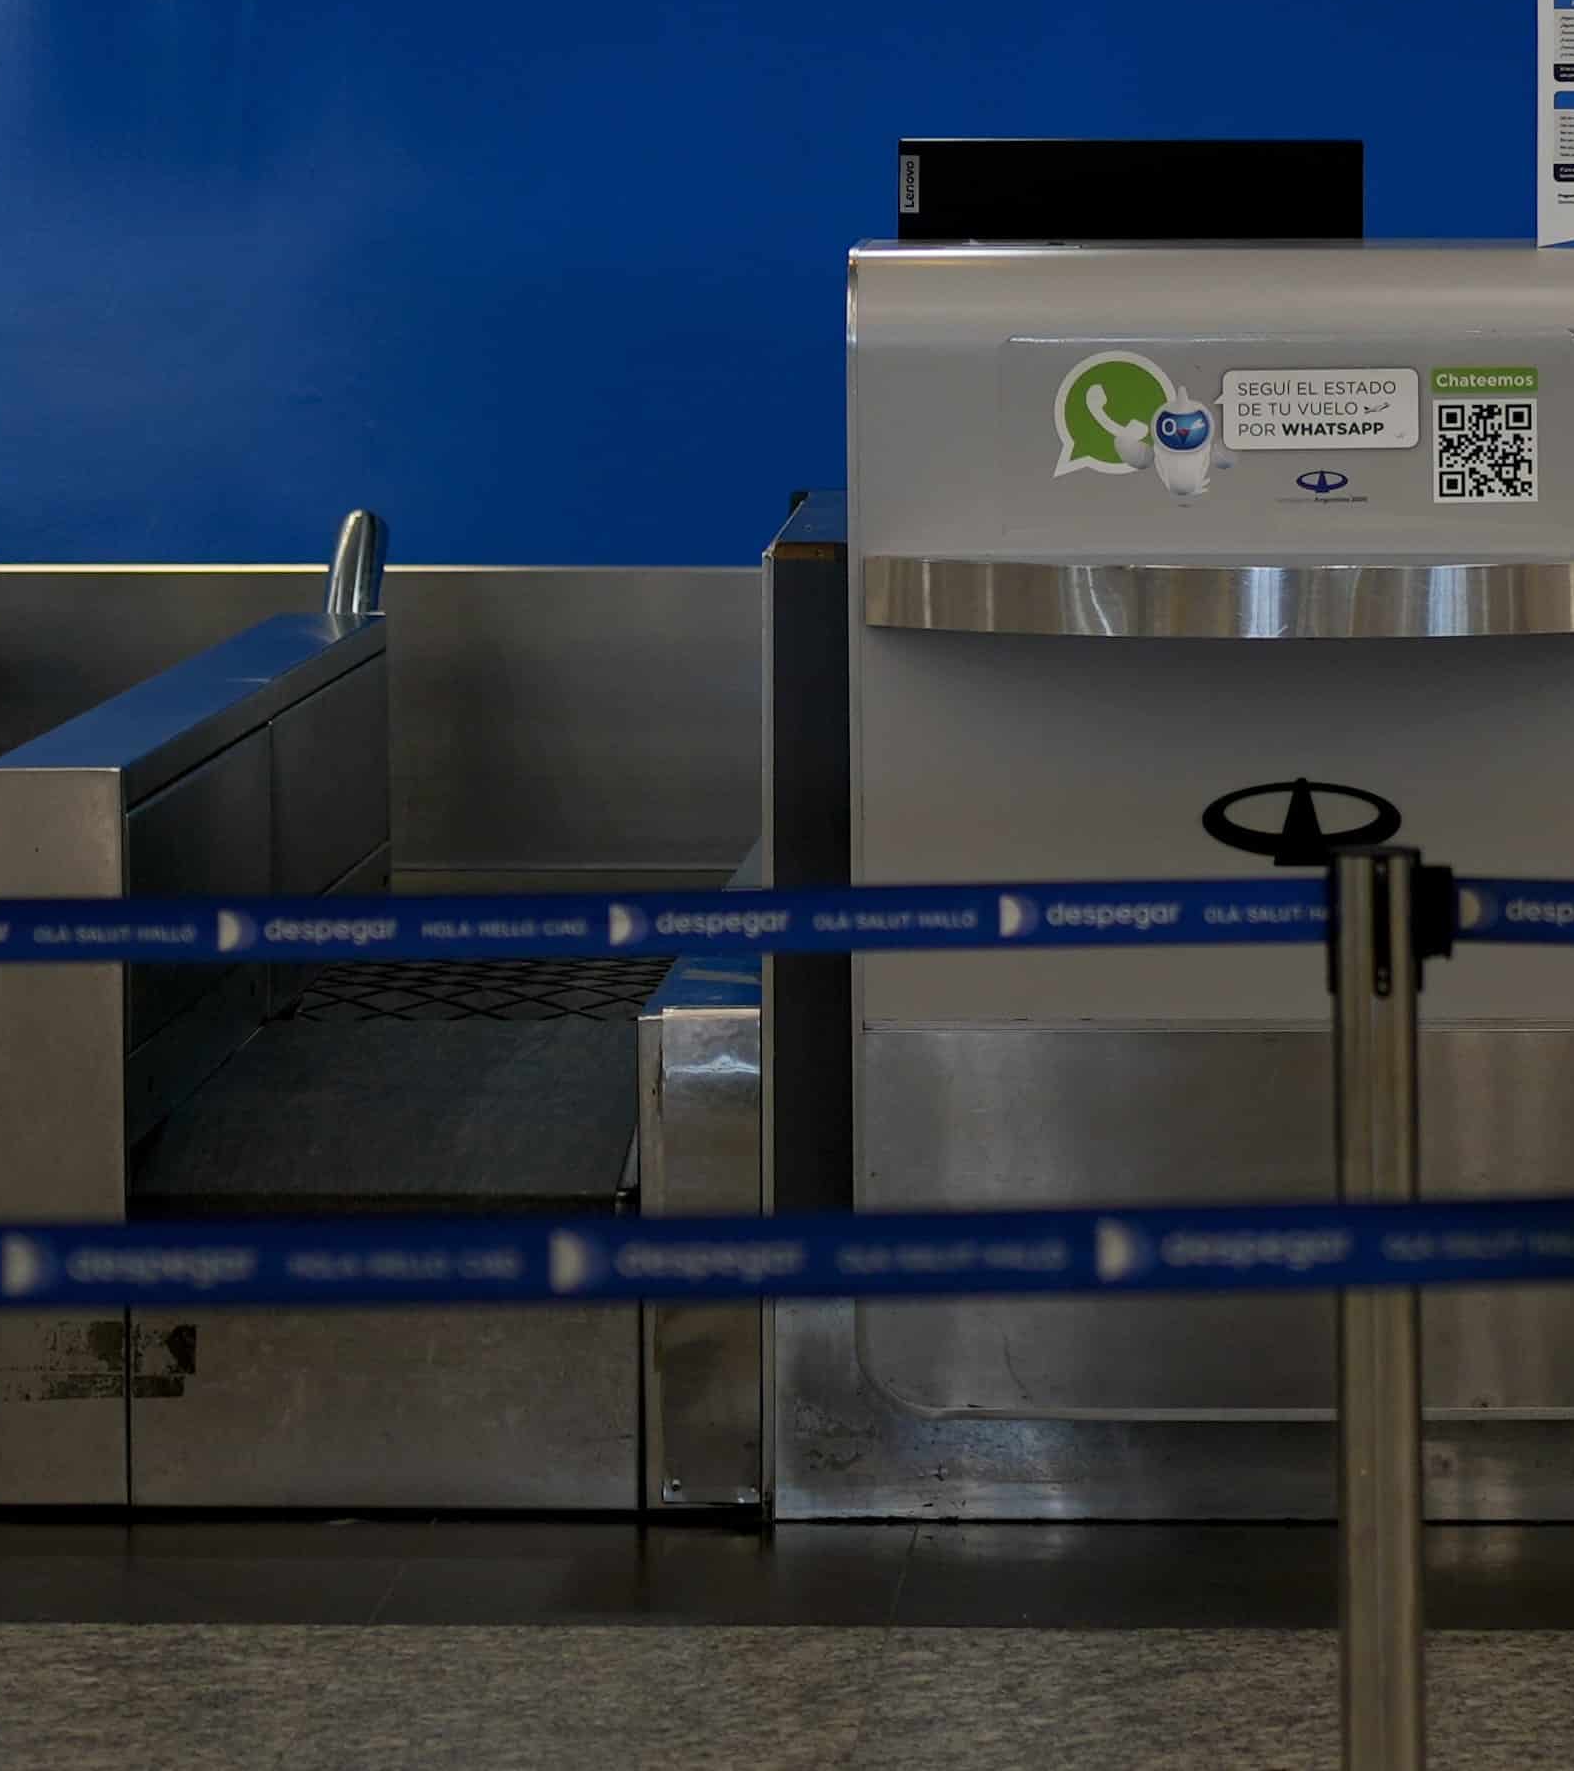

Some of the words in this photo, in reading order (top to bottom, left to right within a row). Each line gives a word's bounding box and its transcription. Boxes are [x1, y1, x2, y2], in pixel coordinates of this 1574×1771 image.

[1238, 379, 1291, 397] SEGUÍ
[1297, 381, 1319, 396] EL
[1324, 380, 1397, 396] ESTADO
[1436, 371, 1534, 389] Chateemos
[1238, 402, 1262, 417] DE
[1268, 402, 1292, 417] TU
[1297, 401, 1358, 417] VUELO
[1238, 422, 1276, 437] POR
[1282, 421, 1385, 436] WHATSAPP
[656, 910, 790, 939] despegar
[1046, 902, 1180, 930] despegar
[264, 918, 396, 946] despegar
